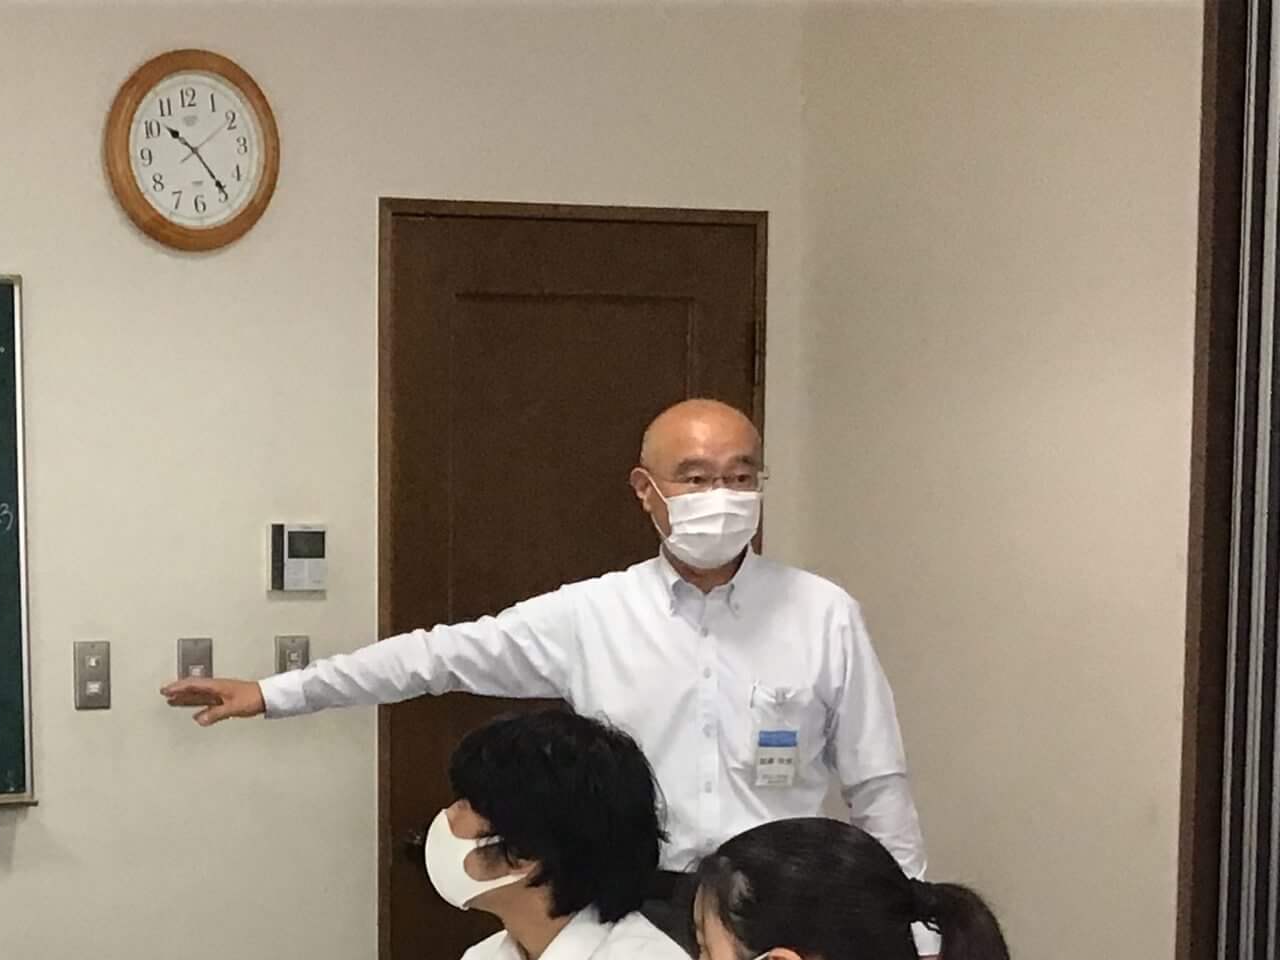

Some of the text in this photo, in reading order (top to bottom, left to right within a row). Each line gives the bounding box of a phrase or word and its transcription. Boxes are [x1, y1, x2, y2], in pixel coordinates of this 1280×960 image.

[159, 97, 172, 117] 11
[180, 87, 197, 108] 12
[209, 92, 217, 112] 1
[144, 119, 162, 139] 10
[225, 109, 238, 131] 2
[236, 135, 248, 155] 3
[140, 147, 153, 167] 9
[152, 172, 165, 193] 8
[172, 189, 183, 210] 7
[193, 194, 206, 214] 6
